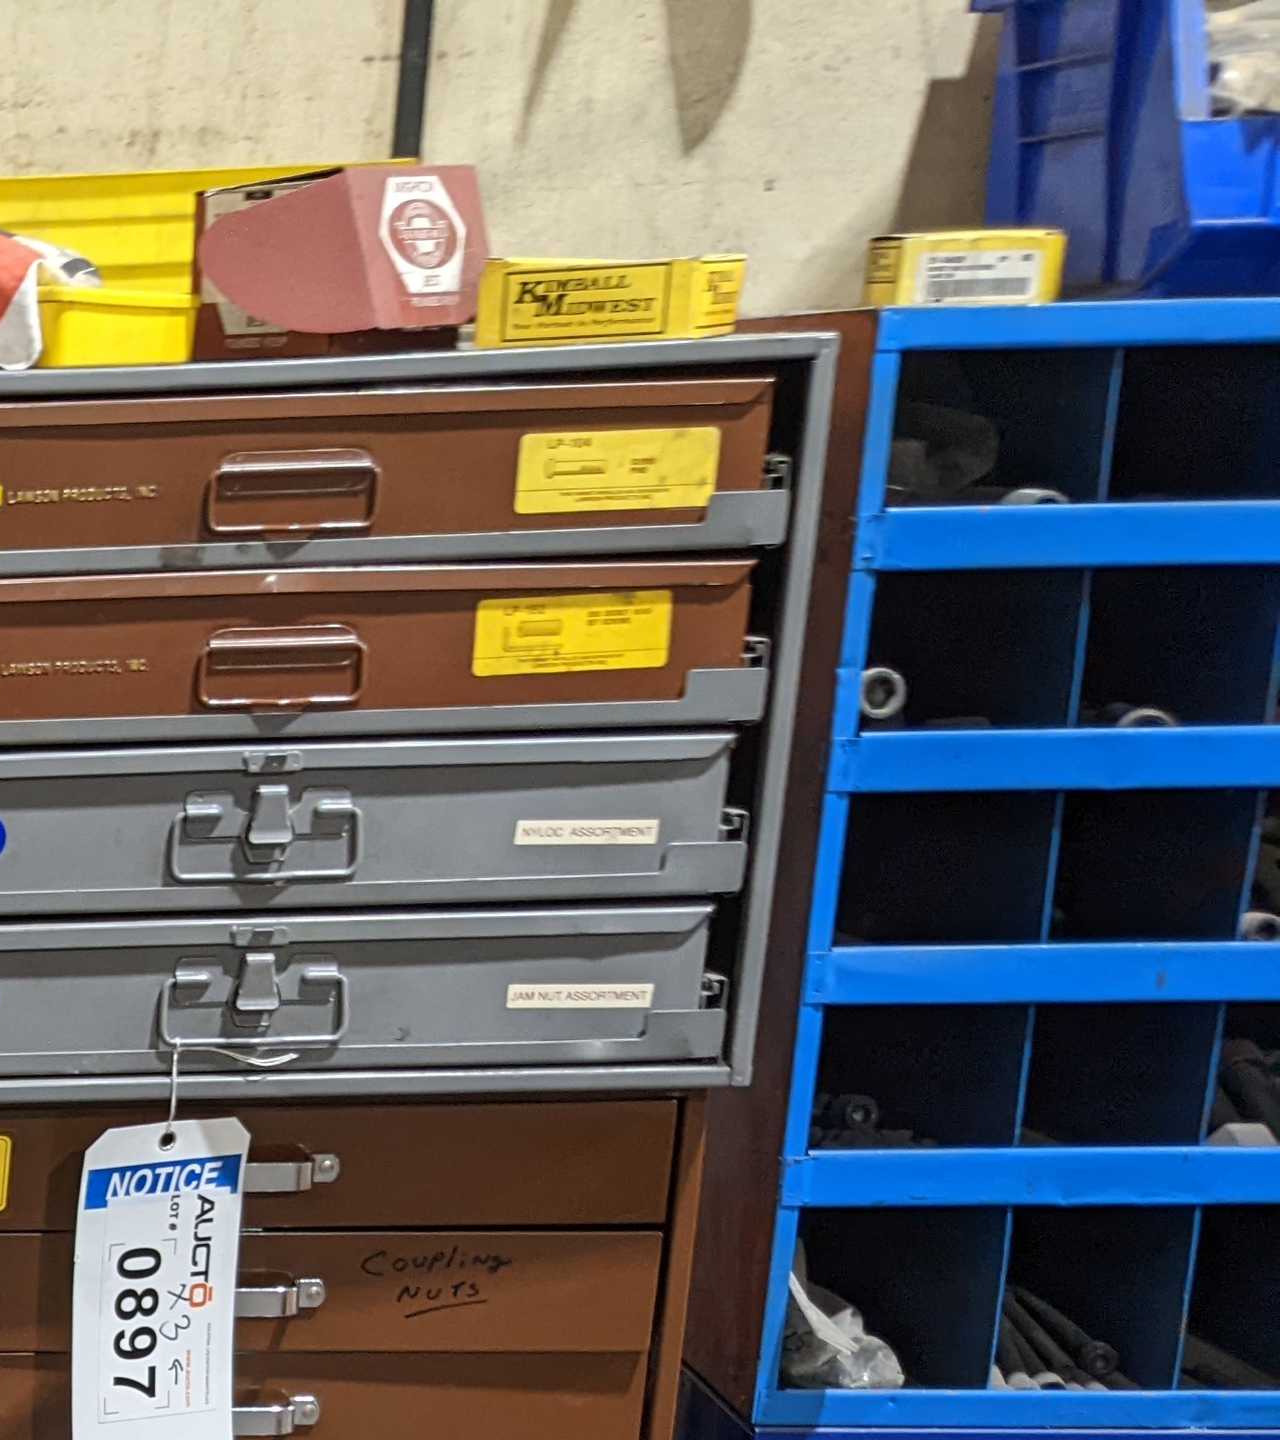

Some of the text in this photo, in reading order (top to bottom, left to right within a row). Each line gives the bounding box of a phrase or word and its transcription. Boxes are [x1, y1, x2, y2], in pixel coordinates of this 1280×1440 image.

[514, 275, 632, 304] KIMBALL
[533, 294, 656, 317] MIDWEST
[106, 1162, 222, 1200] NOTICE
[169, 1194, 180, 1218] LOT
[113, 1247, 162, 1399] 0897
